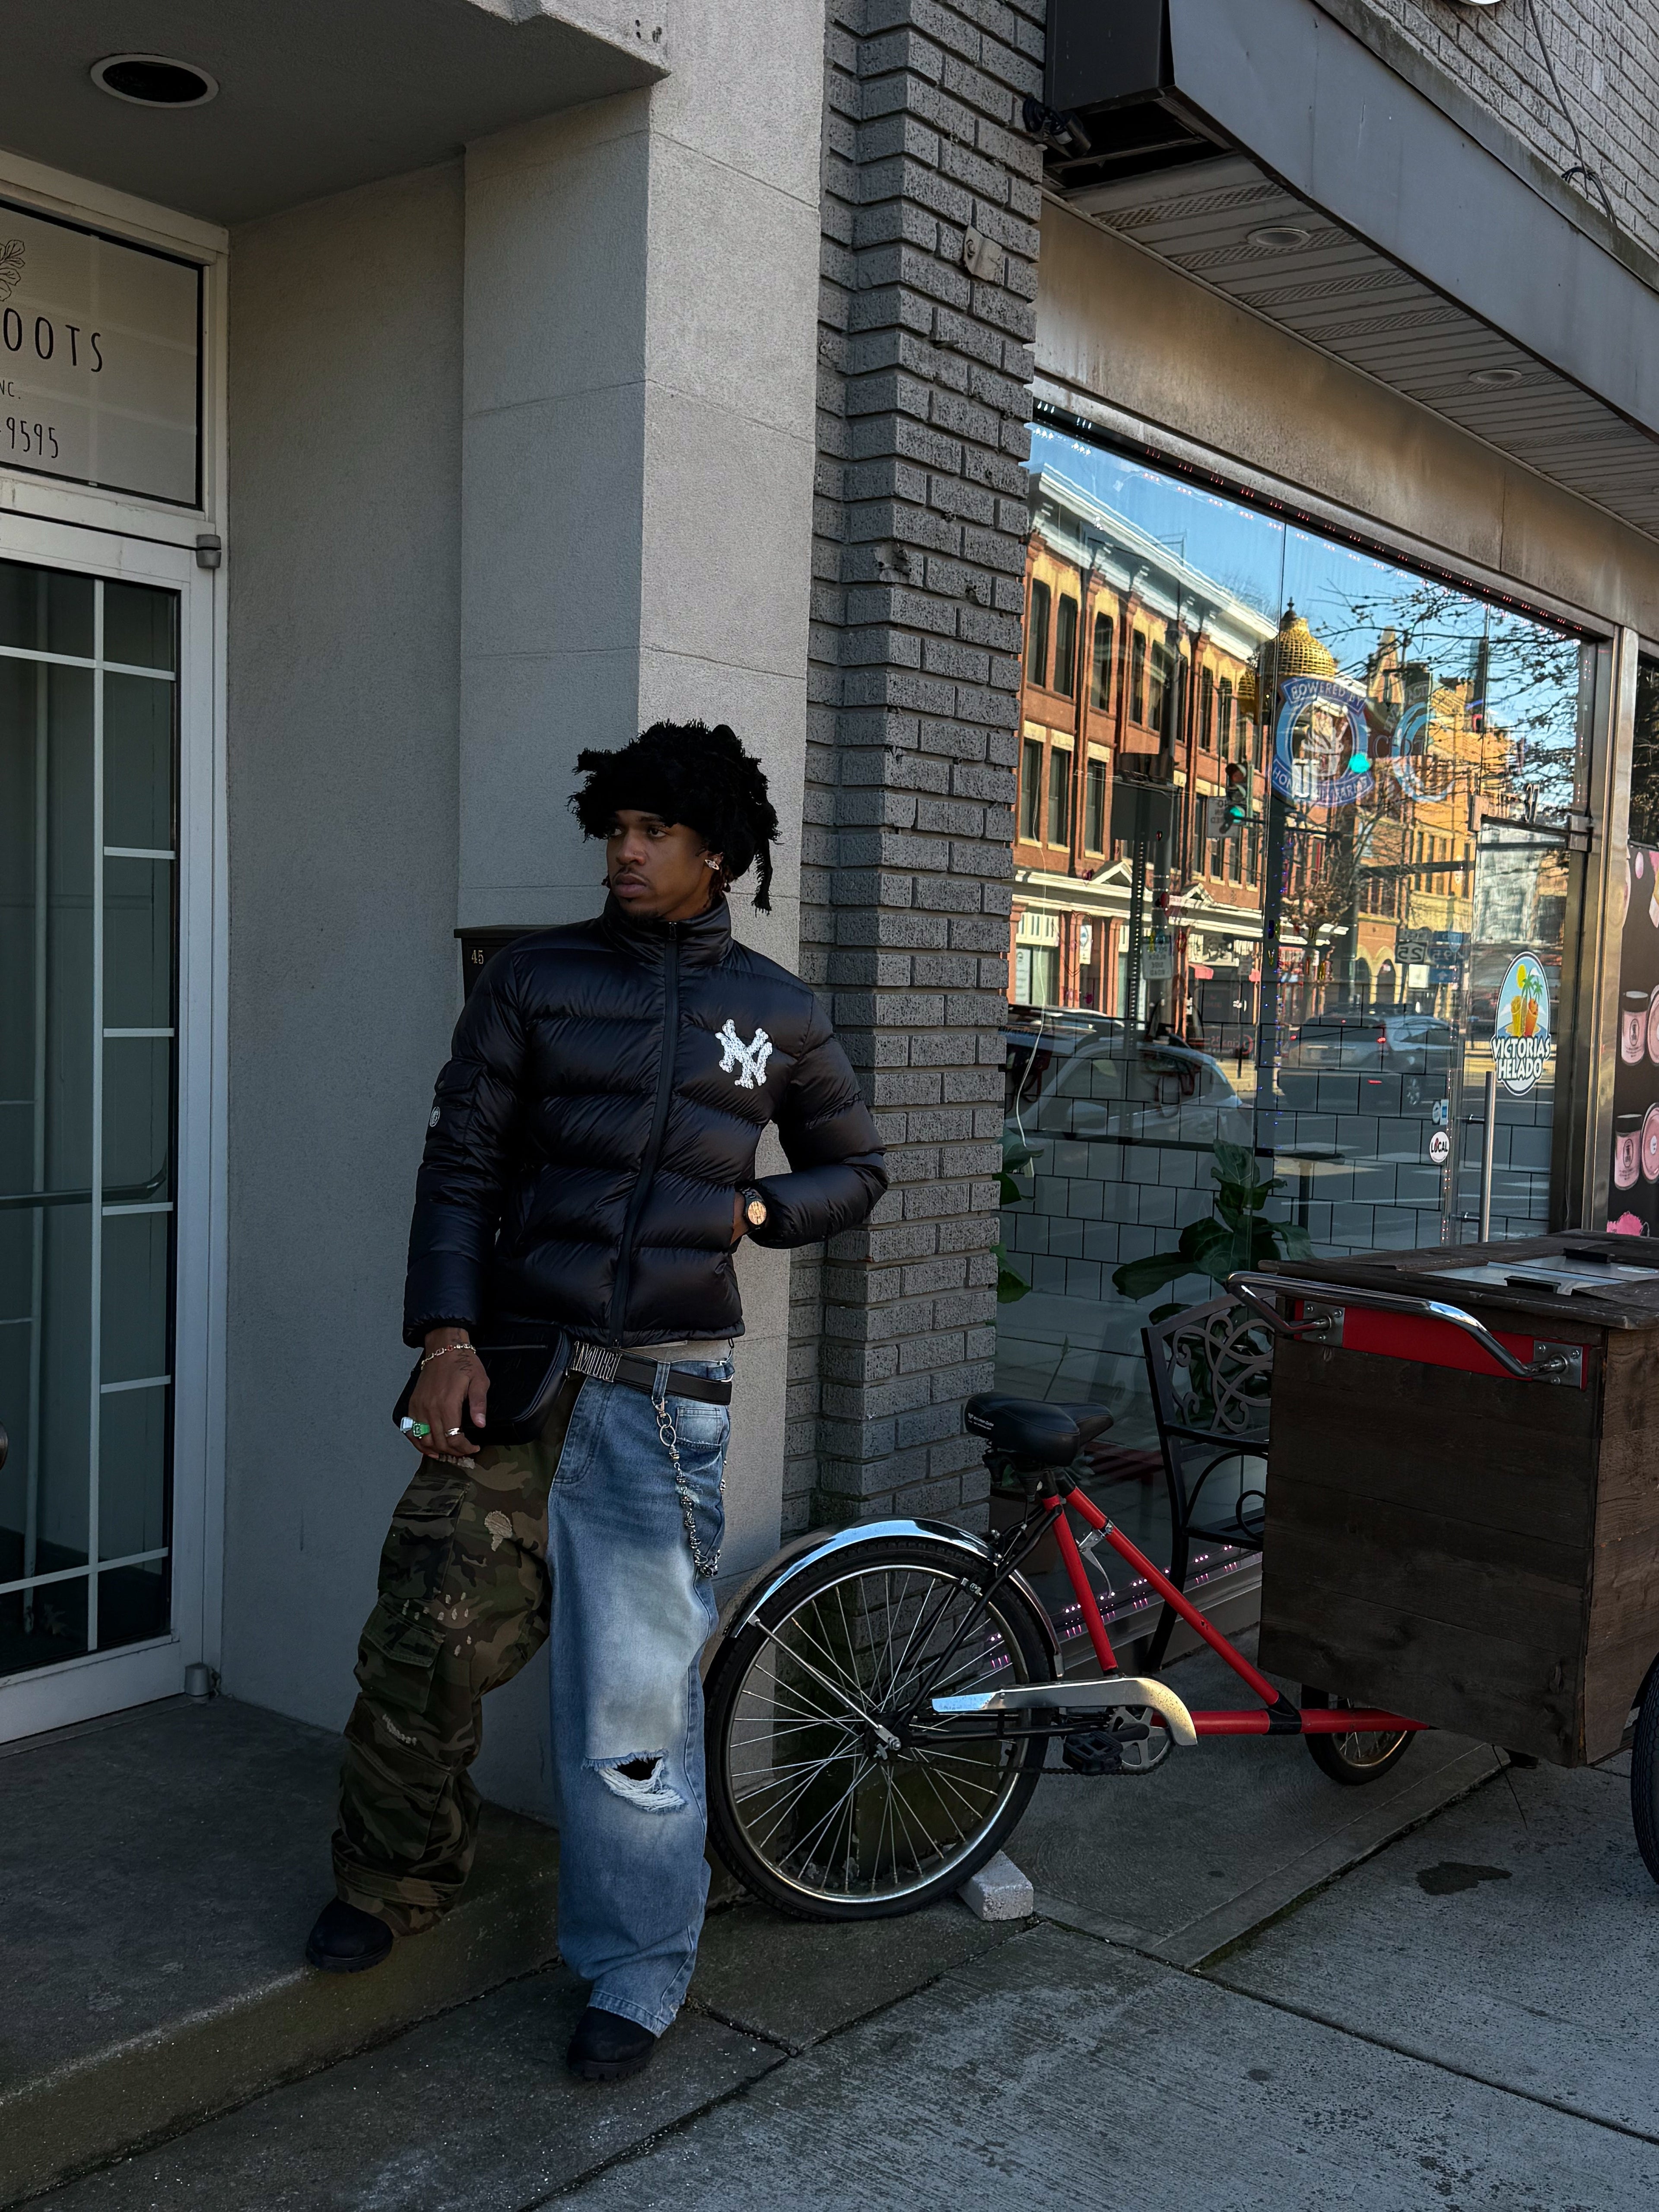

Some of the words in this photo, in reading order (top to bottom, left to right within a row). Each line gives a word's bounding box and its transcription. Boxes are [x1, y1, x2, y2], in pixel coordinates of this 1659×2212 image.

[1291, 681, 1346, 699] POWERED
[471, 950, 484, 964] 45
[715, 1019, 772, 1089] NY
[1492, 1037, 1550, 1058] VICTORIAS
[1498, 1058, 1542, 1079] HELADO
